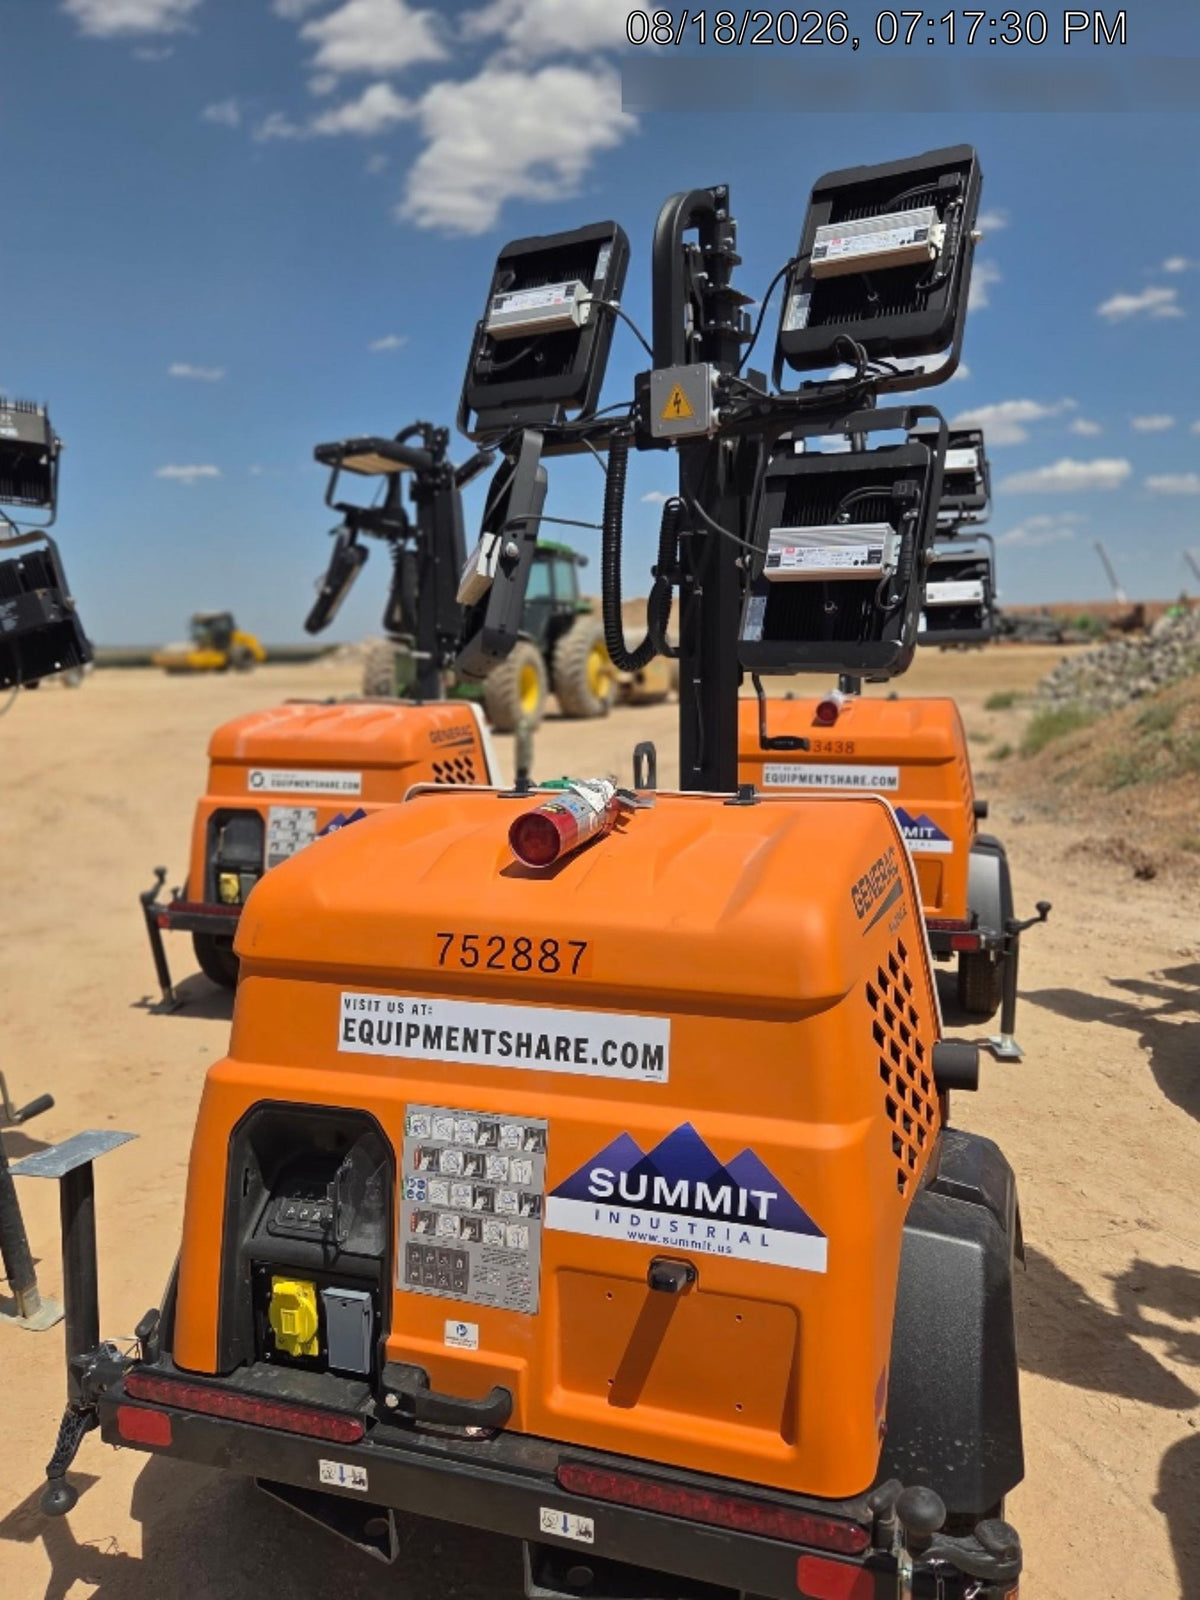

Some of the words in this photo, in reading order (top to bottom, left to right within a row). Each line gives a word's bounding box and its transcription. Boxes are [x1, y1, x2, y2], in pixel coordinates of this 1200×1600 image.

[813, 740, 855, 754] 3438
[765, 773, 896, 786] EQUIPMENTSHARE.COM
[903, 826, 935, 838] MIT
[436, 932, 588, 974] 752887
[344, 998, 381, 1013] VISIT
[387, 1002, 405, 1014] US
[411, 1004, 433, 1016] AT:
[343, 1017, 664, 1072] EQUIPMENTSHARE.COM
[587, 1167, 778, 1221] SUMMIT
[594, 1208, 770, 1247] INDUSTRIAL
[627, 1230, 732, 1254] www.summit.us
